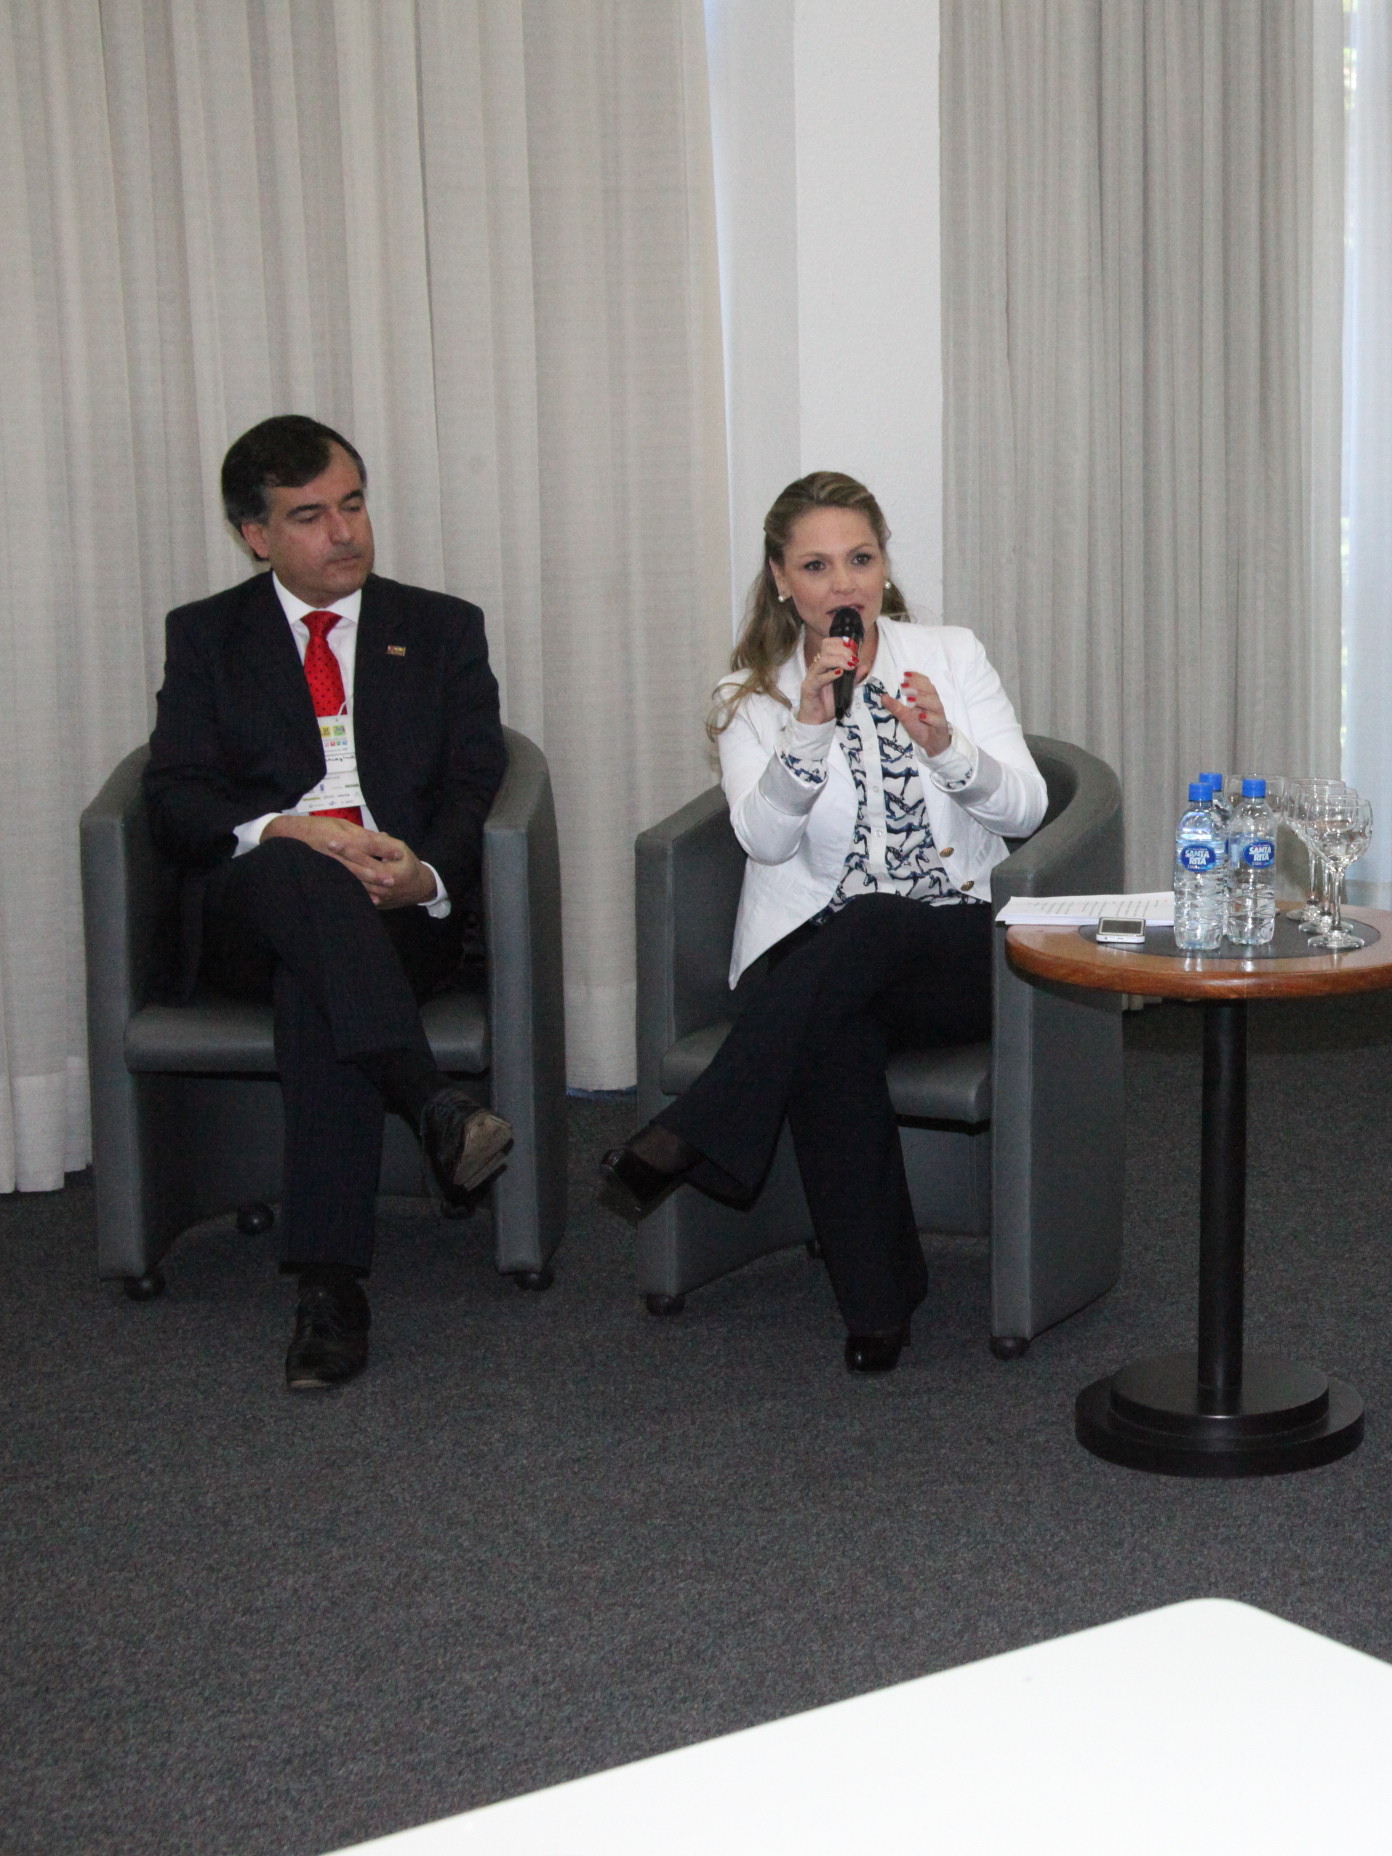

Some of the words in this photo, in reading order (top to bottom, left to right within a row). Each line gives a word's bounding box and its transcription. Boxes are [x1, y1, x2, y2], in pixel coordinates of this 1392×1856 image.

[1185, 849, 1210, 858] SANTA
[1248, 845, 1272, 855] SANTA
[1188, 856, 1207, 865] RITA
[1253, 853, 1270, 862] RITA
